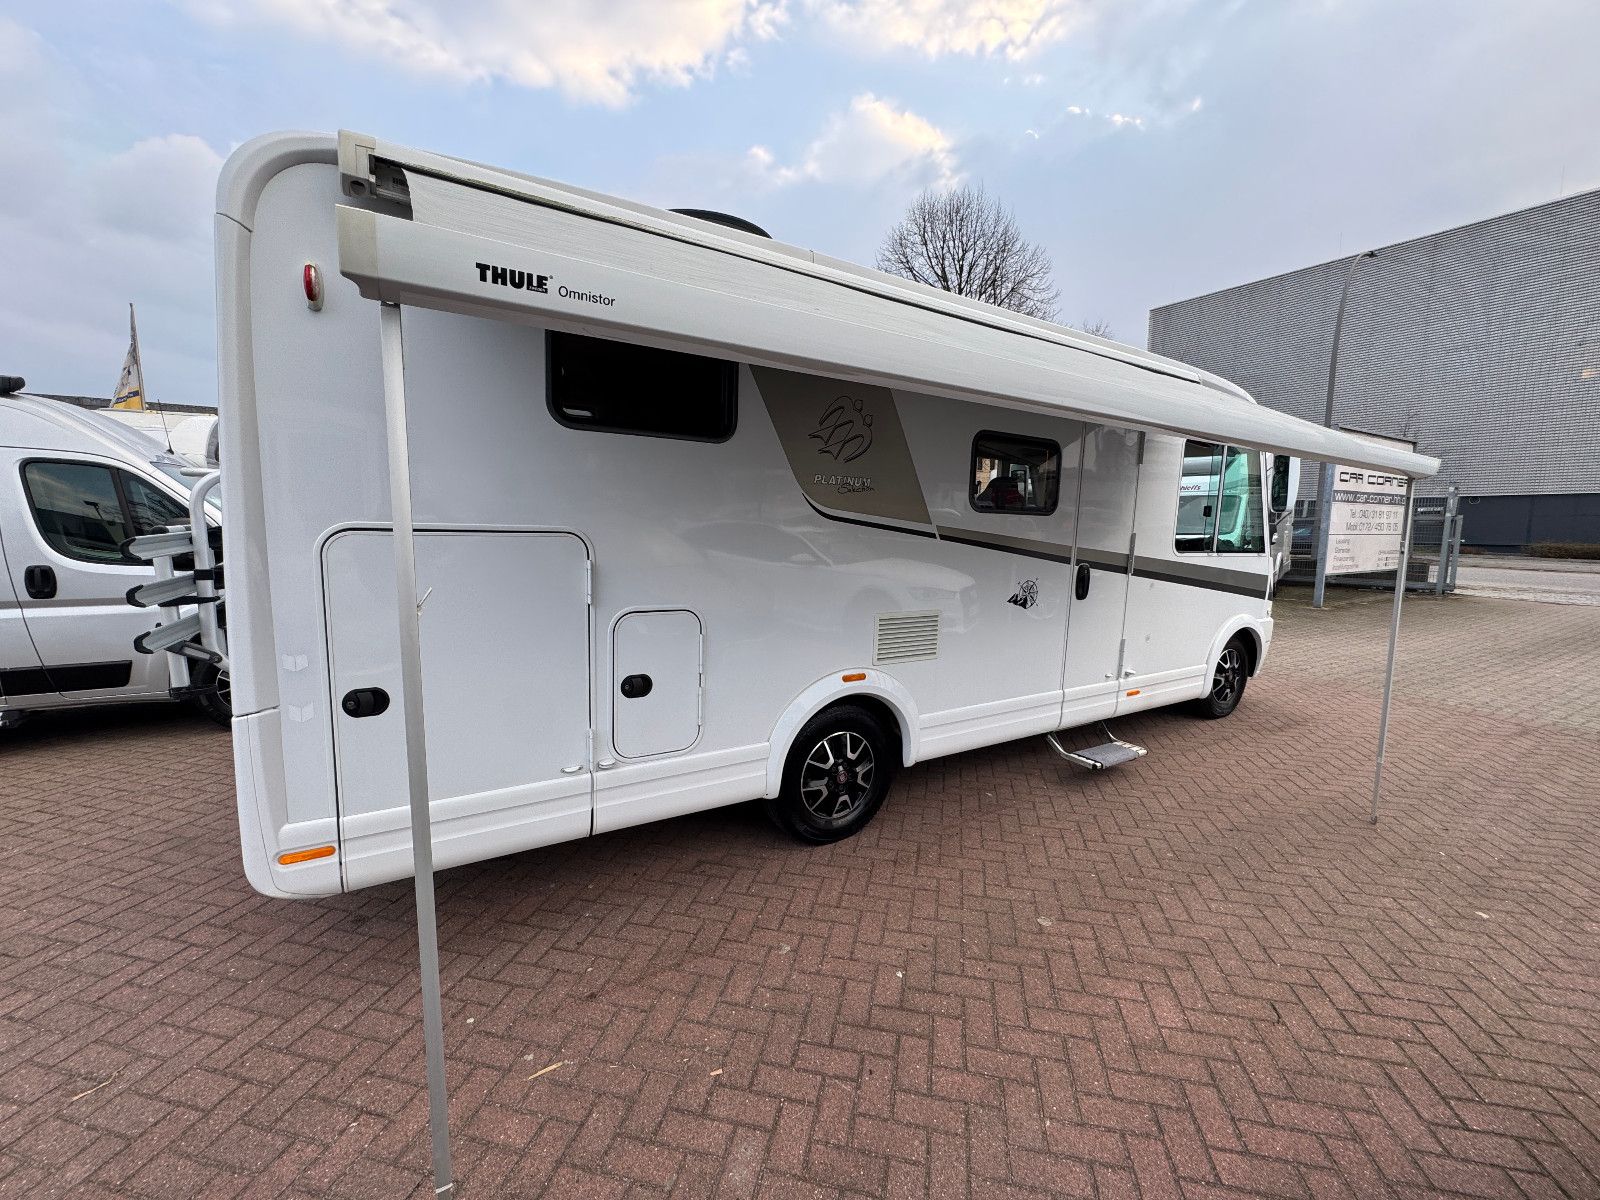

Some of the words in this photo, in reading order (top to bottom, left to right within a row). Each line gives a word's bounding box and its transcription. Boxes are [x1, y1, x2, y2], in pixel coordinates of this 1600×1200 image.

[476, 262, 549, 294] THULE
[558, 285, 616, 307] Omnistor
[814, 474, 871, 487] PLATINUM
[1339, 472, 1364, 484] CAR
